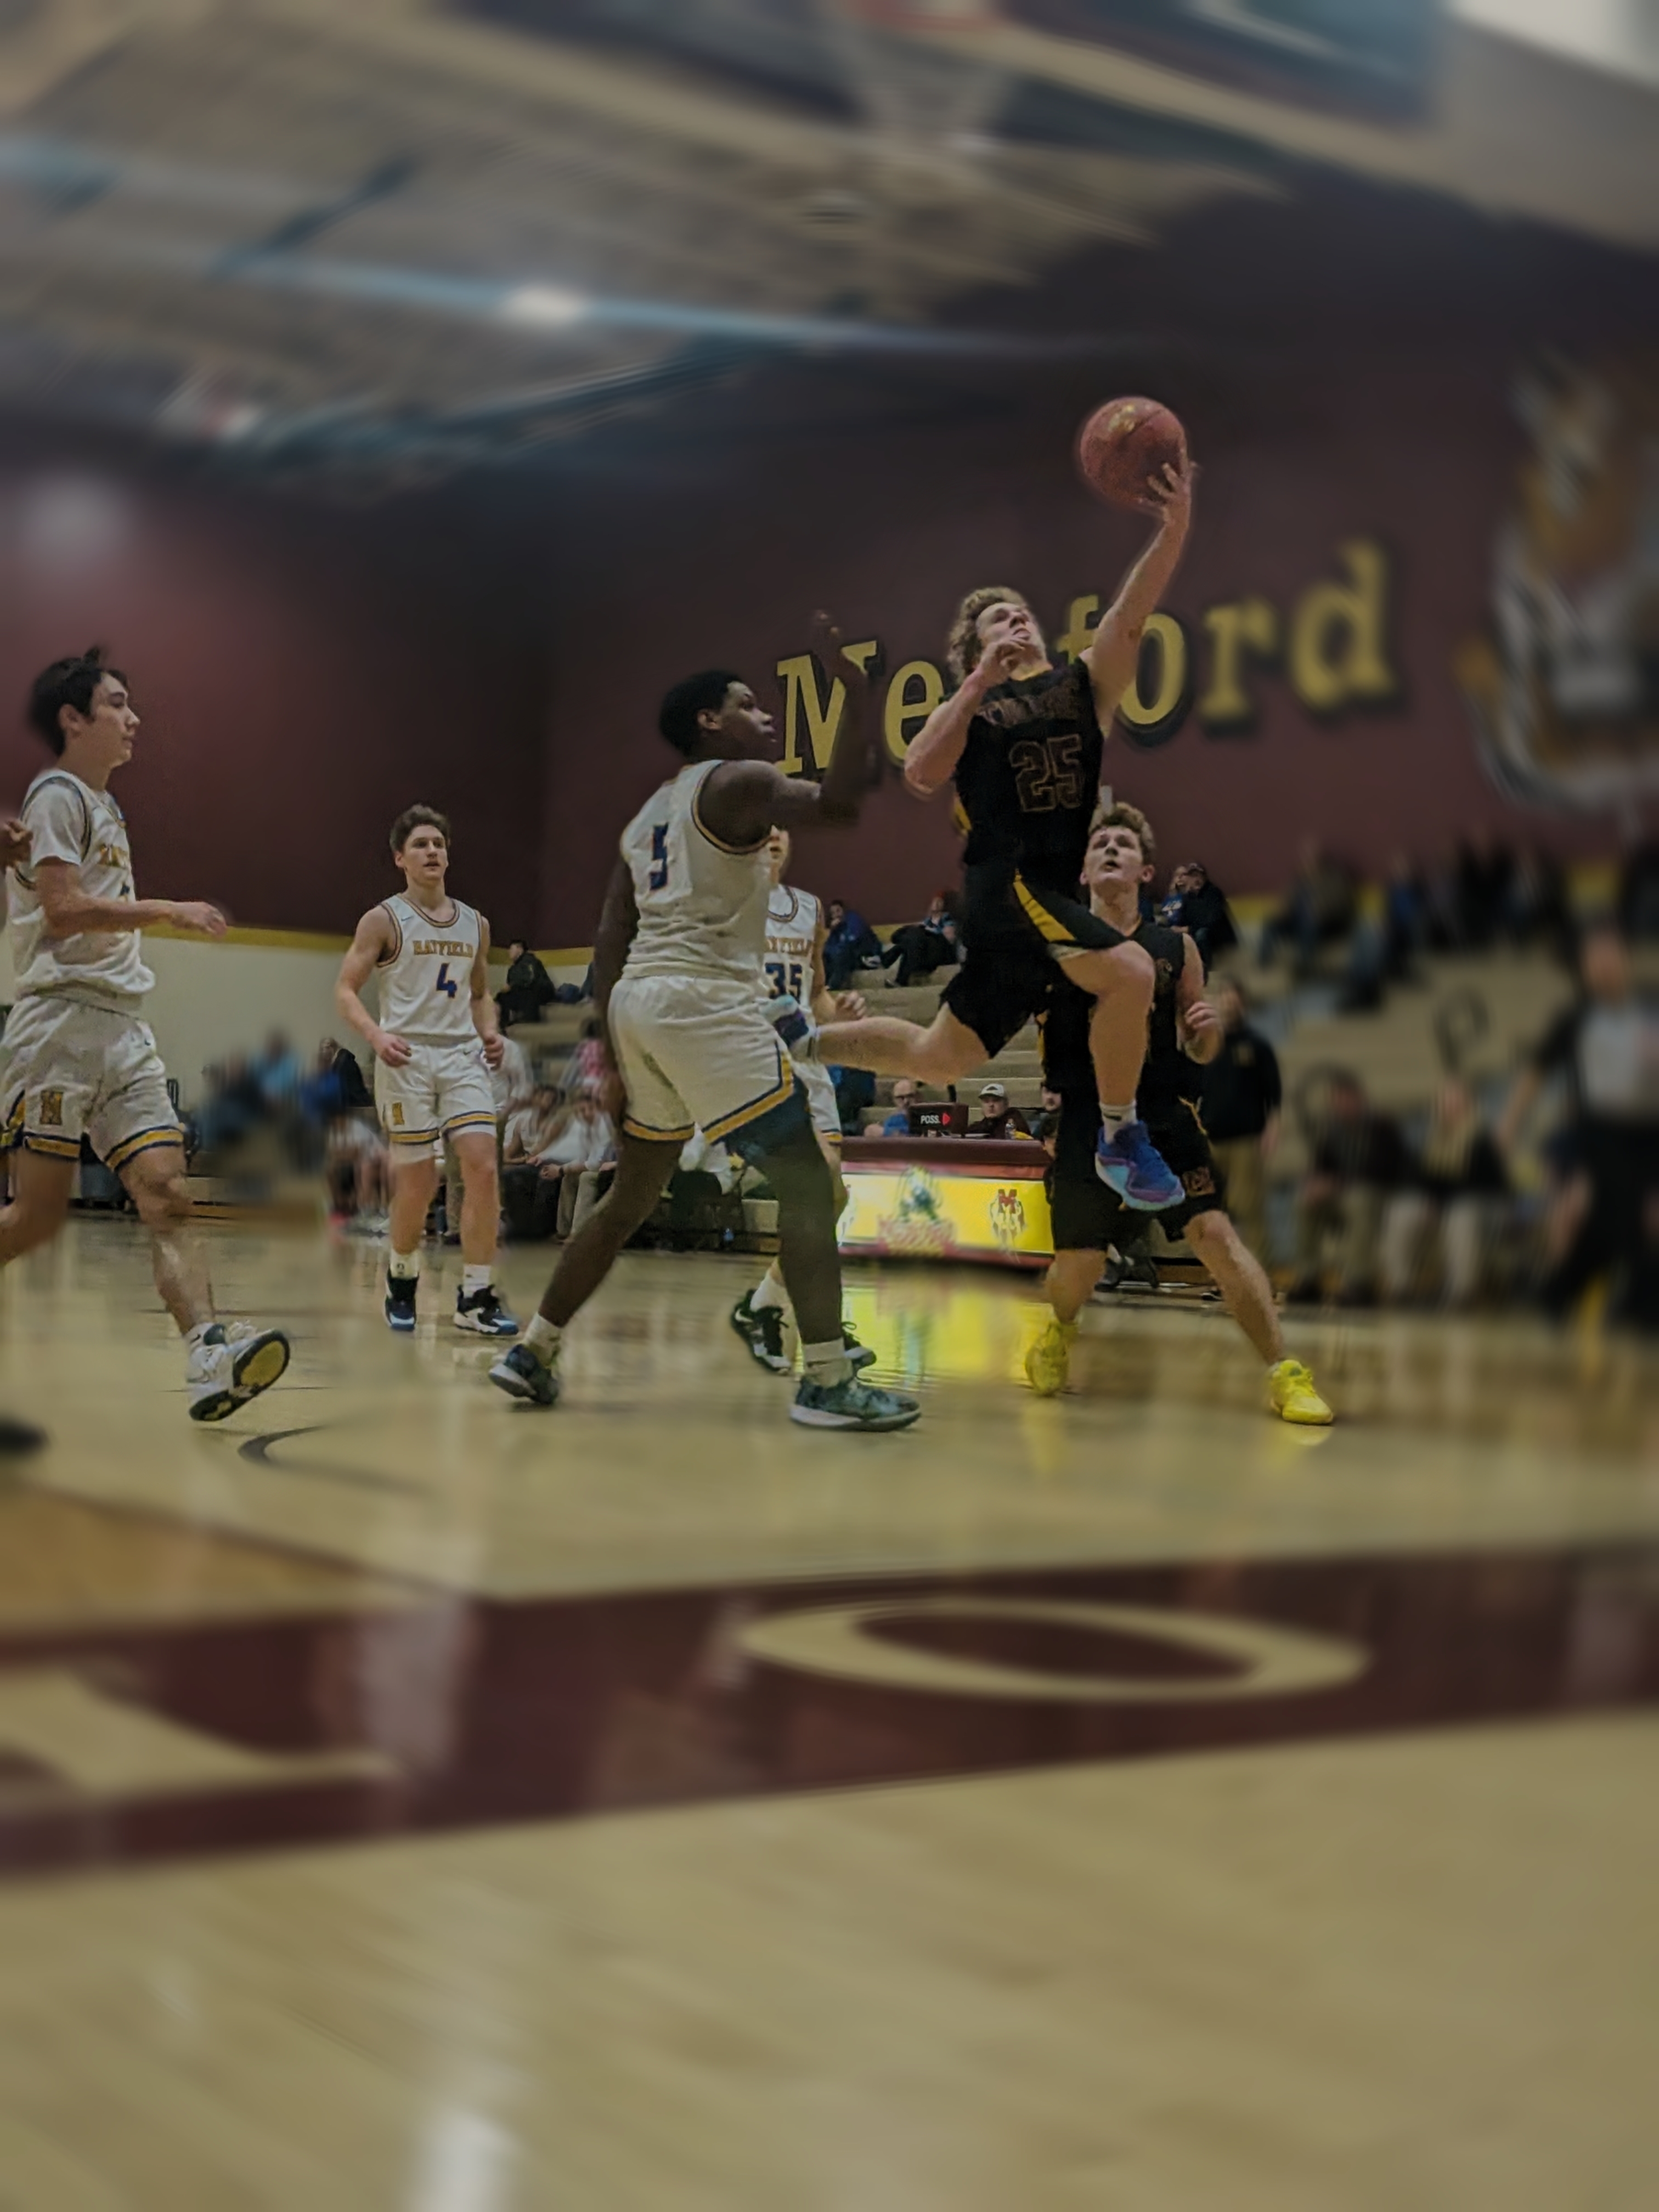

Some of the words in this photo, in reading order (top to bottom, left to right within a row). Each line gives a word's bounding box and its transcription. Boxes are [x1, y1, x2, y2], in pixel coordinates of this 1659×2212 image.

[774, 541, 1393, 775] Meford
[1009, 733, 1085, 812] 25
[437, 963, 457, 998] 4
[765, 963, 802, 1003] 35
